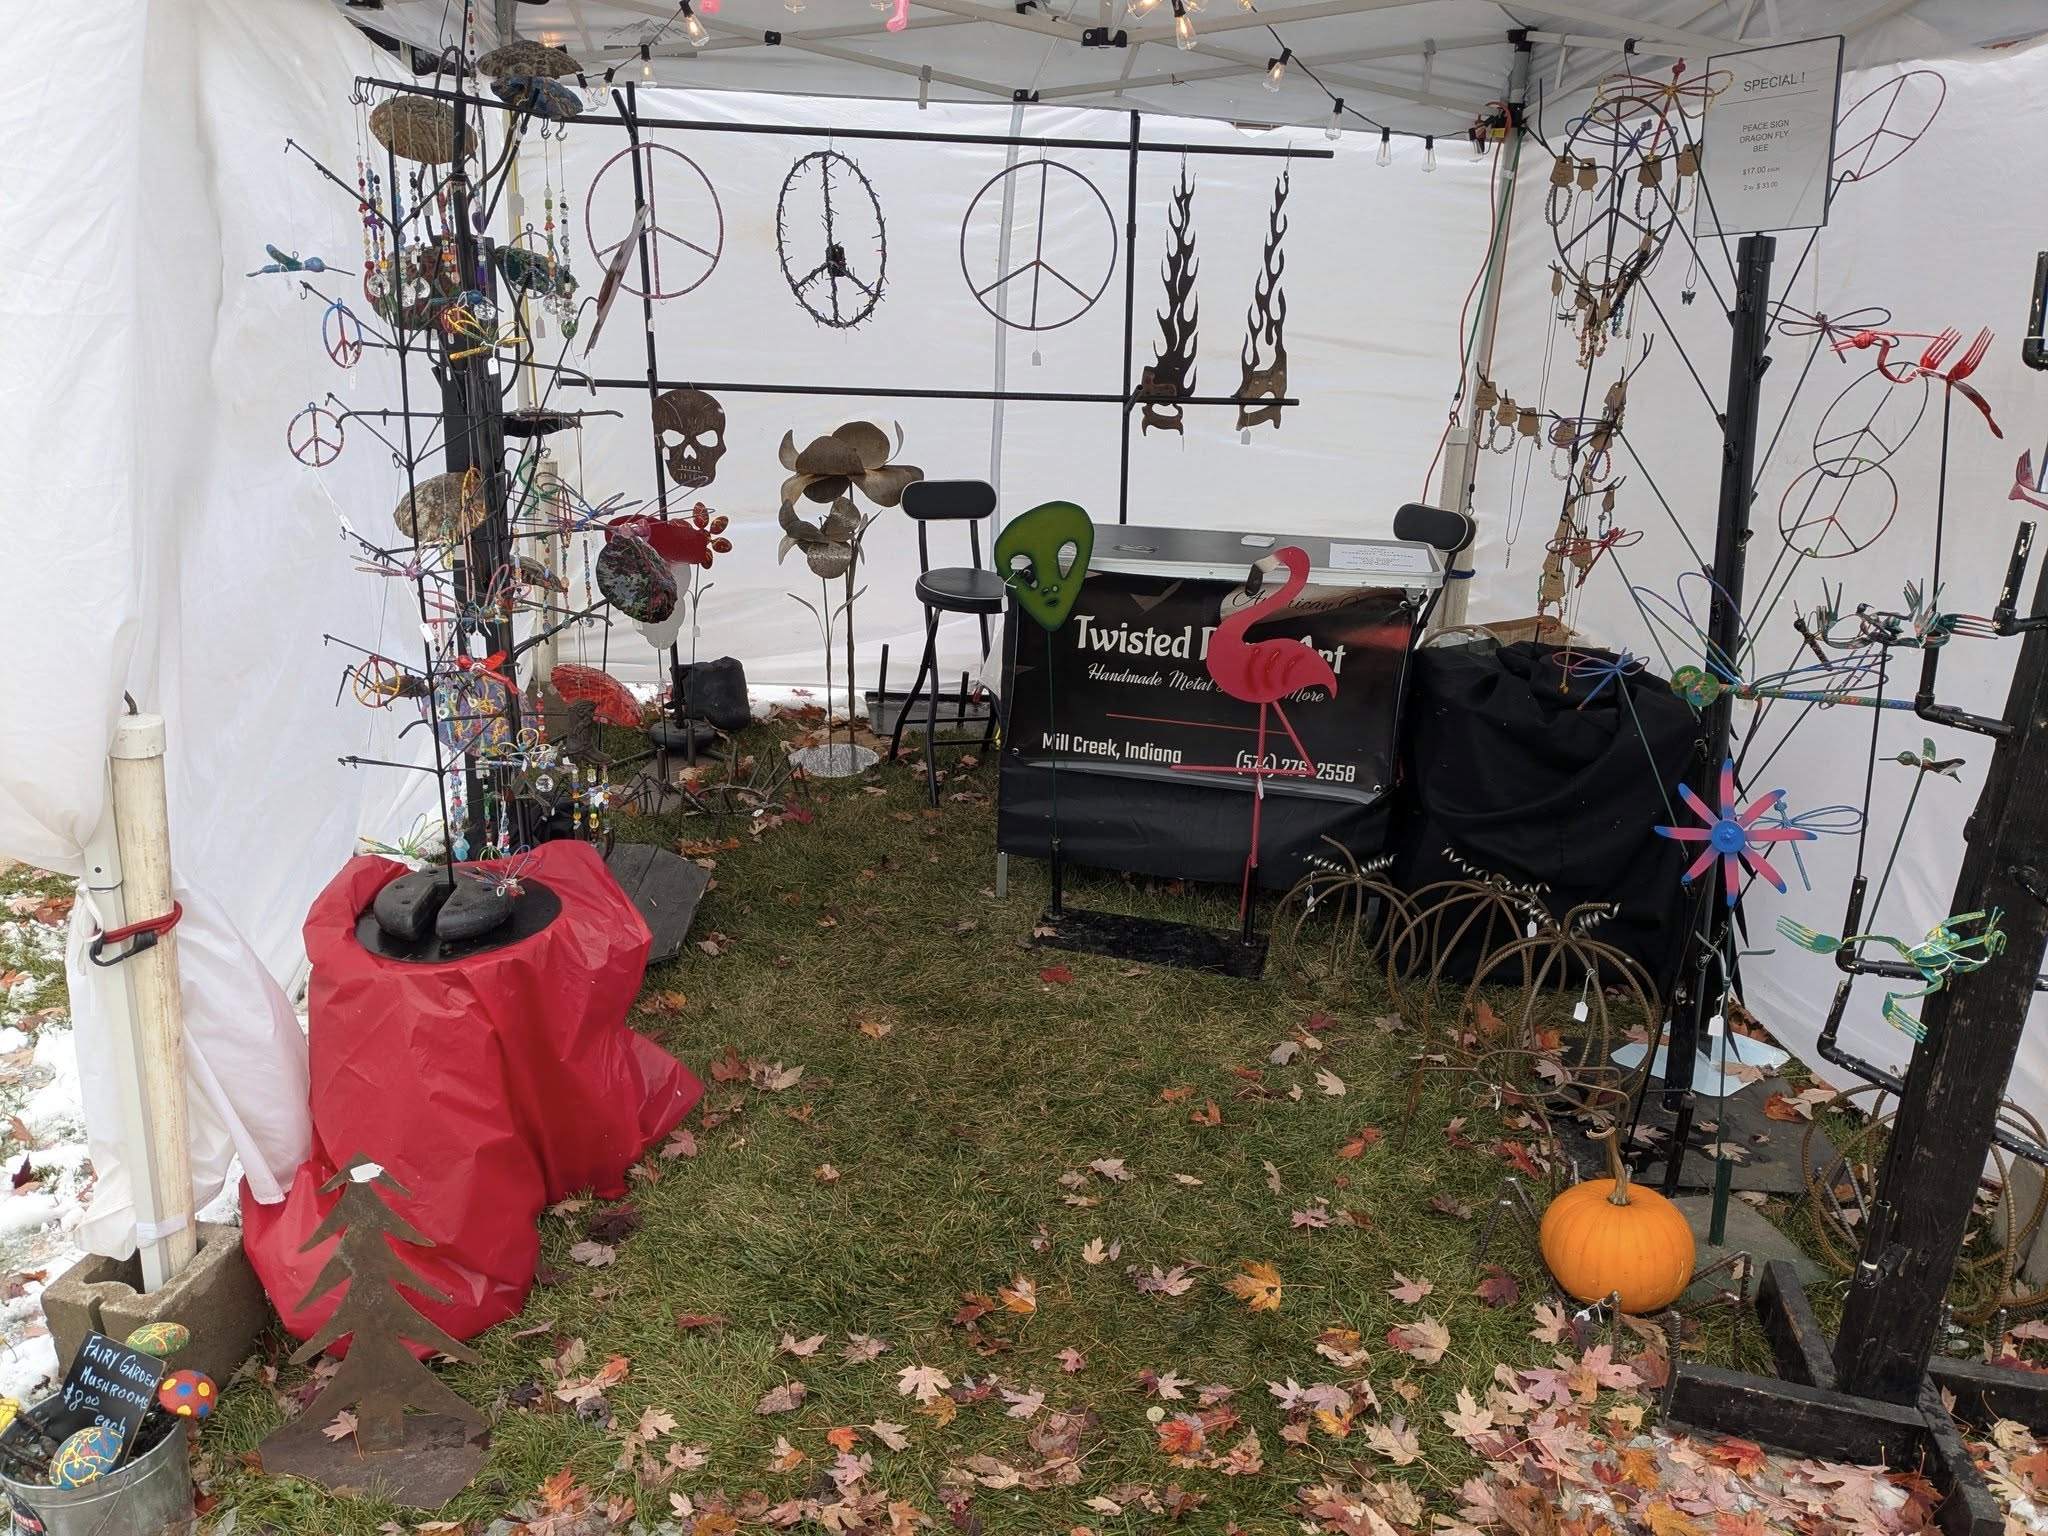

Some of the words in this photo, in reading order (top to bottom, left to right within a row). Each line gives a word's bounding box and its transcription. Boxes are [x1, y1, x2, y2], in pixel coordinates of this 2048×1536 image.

[1743, 73, 1798, 93] SPECIAL
[1742, 122, 1769, 132] PEACE
[1769, 120, 1790, 128] SIGN
[1740, 132, 1774, 143] DRAGON
[1752, 144, 1769, 152] BEE
[1742, 166, 1766, 176] $17.00
[1073, 614, 1192, 659] Twisted
[1088, 663, 1162, 686] Handmade
[1169, 670, 1213, 691] Metal
[1042, 733, 1069, 751] Mill
[1073, 736, 1121, 760] Creek,
[1125, 741, 1182, 764] Indiana
[1315, 762, 1356, 783] 2558
[82, 1335, 121, 1370] FAIRY
[119, 1354, 157, 1388] GARDEN
